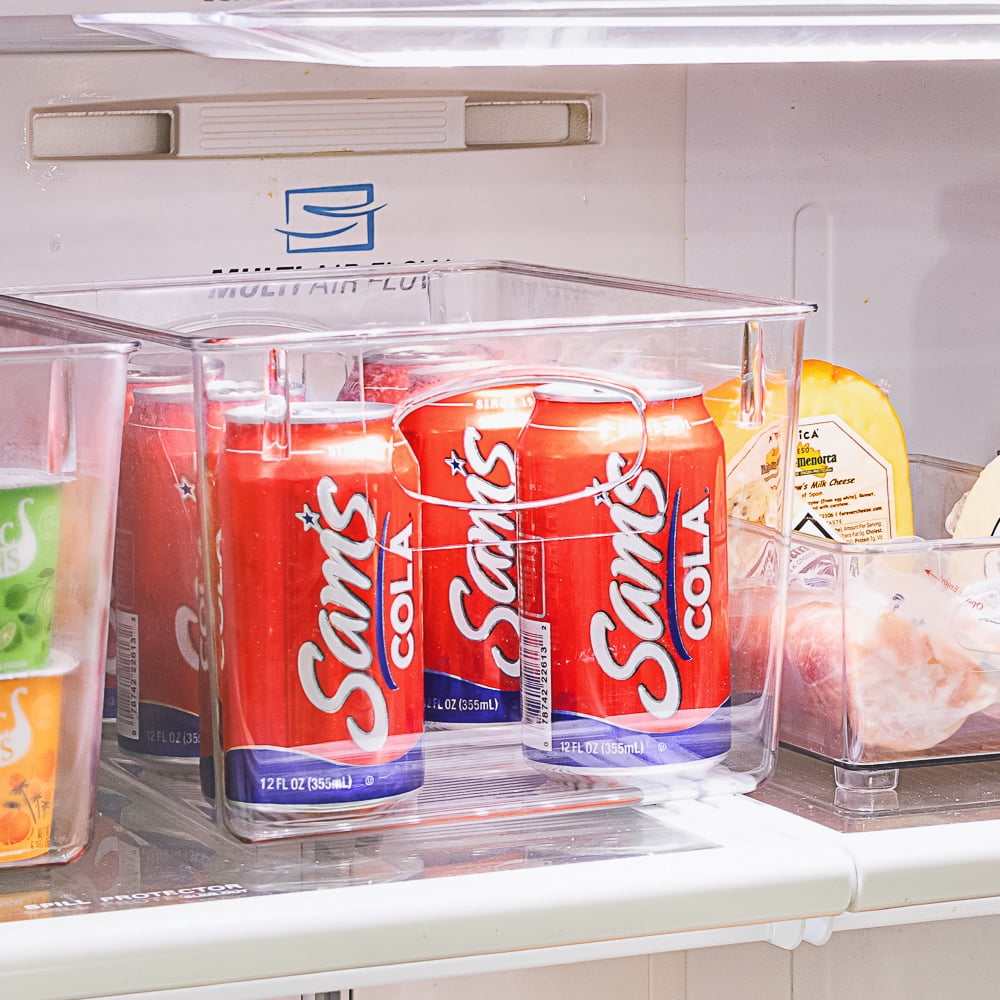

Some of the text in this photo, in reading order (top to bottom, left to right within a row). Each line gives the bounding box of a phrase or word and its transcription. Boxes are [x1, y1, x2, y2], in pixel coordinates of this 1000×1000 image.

[368, 258, 451, 292] FLO
[810, 480, 827, 489] Milk
[829, 477, 856, 487] Cheese
[681, 496, 714, 642] COLA
[388, 521, 415, 671] COLA
[540, 646, 549, 684] 22613
[444, 699, 457, 711] OZ
[458, 697, 499, 712] (355mL)
[541, 688, 549, 725] 78742
[157, 731, 168, 743] FL
[169, 731, 181, 744] OZ
[559, 740, 645, 755] 12 FL OZ (355mL)
[260, 774, 352, 792] 12 FL OZ (355mL)
[24, 882, 243, 911] SPILL PROTECTOR
